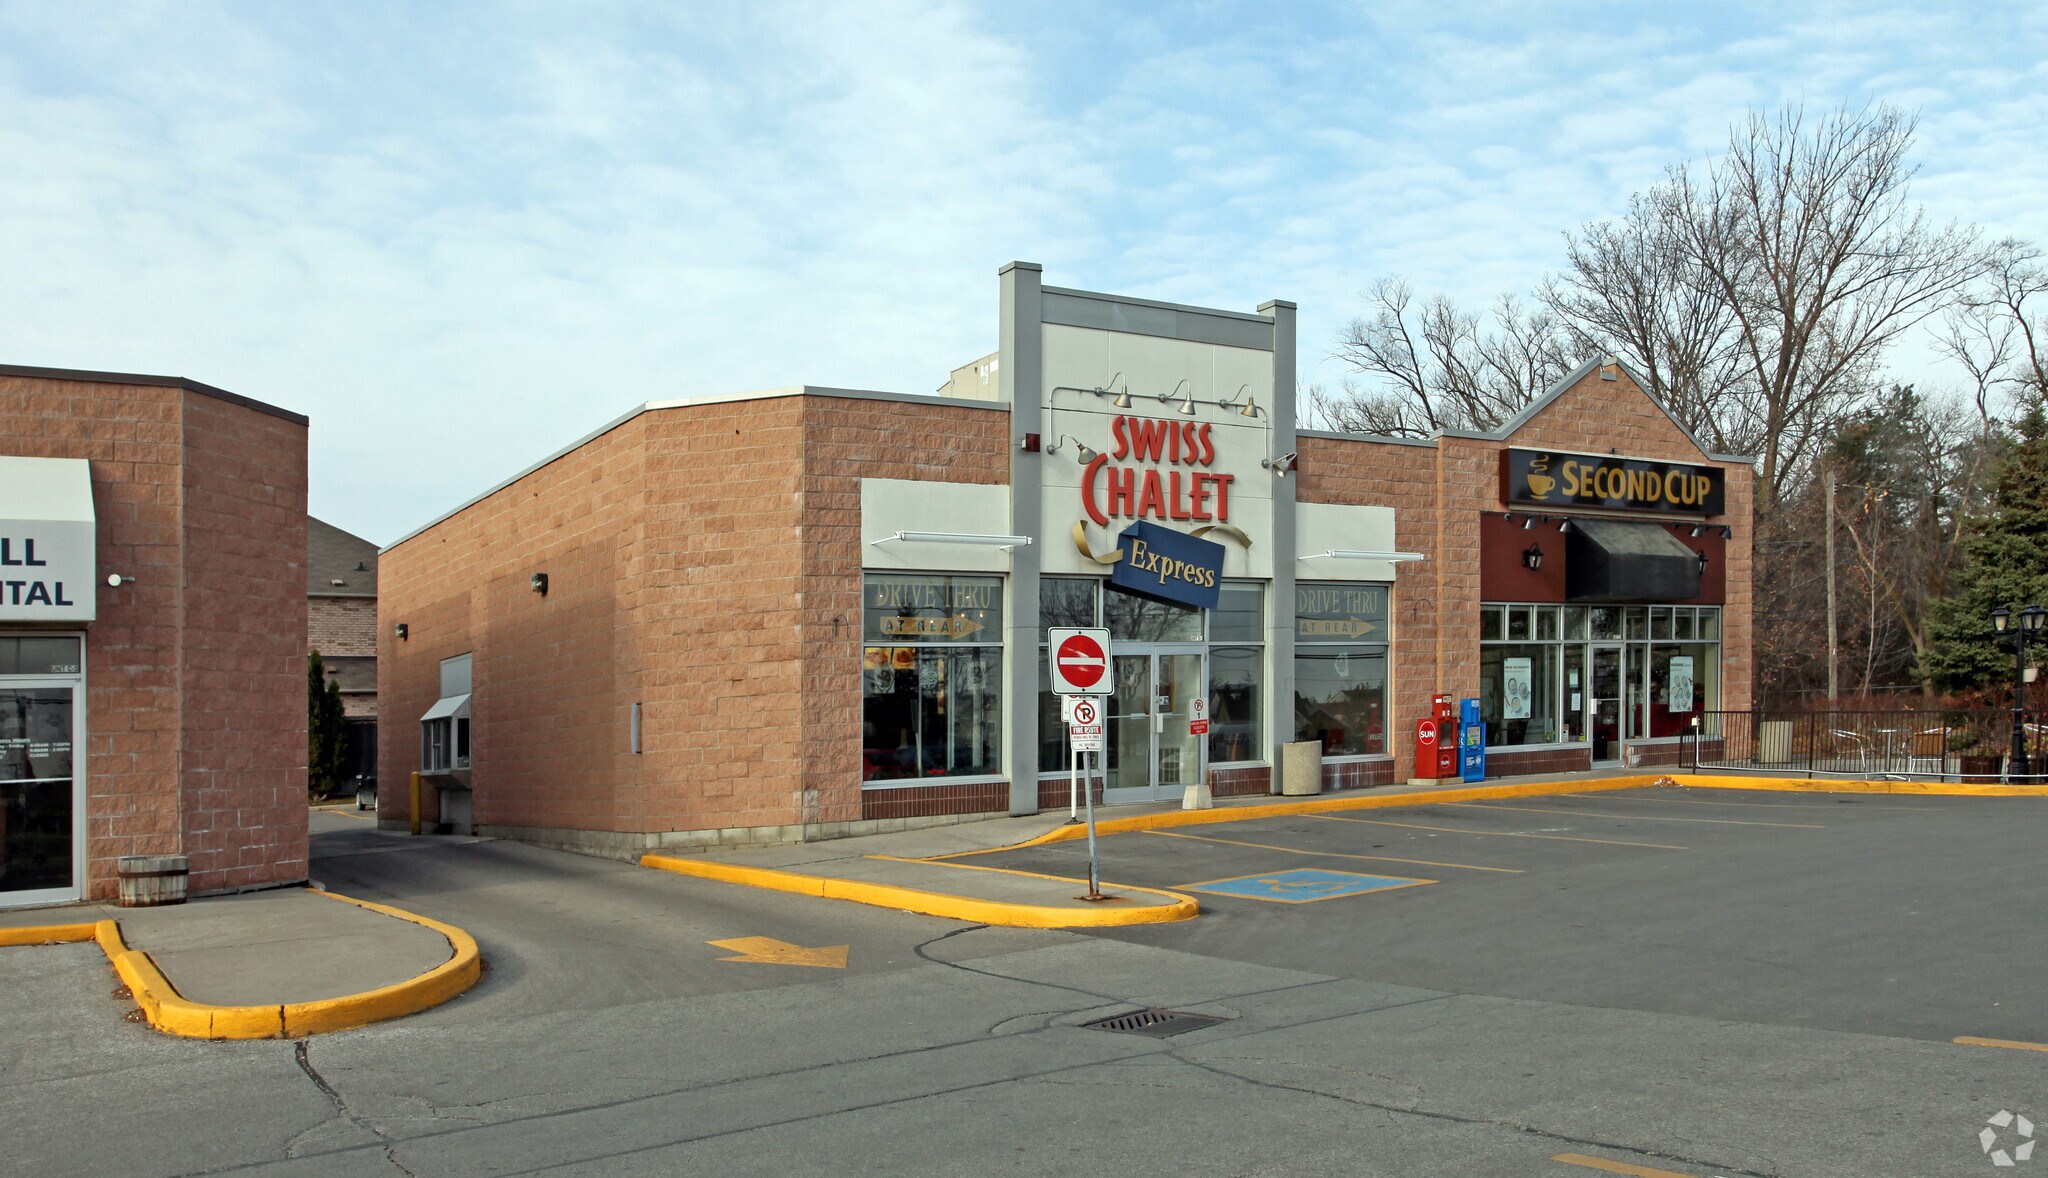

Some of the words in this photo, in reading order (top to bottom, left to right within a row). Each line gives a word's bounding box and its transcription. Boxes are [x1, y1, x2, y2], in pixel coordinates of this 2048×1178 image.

[1112, 415, 1215, 466] SWISS
[1082, 453, 1234, 527] CHALET
[1562, 460, 1662, 501] SECOND
[1665, 469, 1711, 505] CUP
[1129, 538, 1216, 588] Express
[0, 580, 73, 606] TAL
[875, 579, 936, 608] DRIVE
[944, 581, 992, 609] THRU
[1298, 589, 1340, 613] DRIVE
[1344, 590, 1377, 614] THRU
[885, 619, 904, 632] AT
[917, 619, 962, 633] REAR
[1301, 622, 1315, 633] AT
[1325, 622, 1358, 633] REAR
[1073, 726, 1083, 734] FIRE
[1420, 730, 1435, 738] SUN
